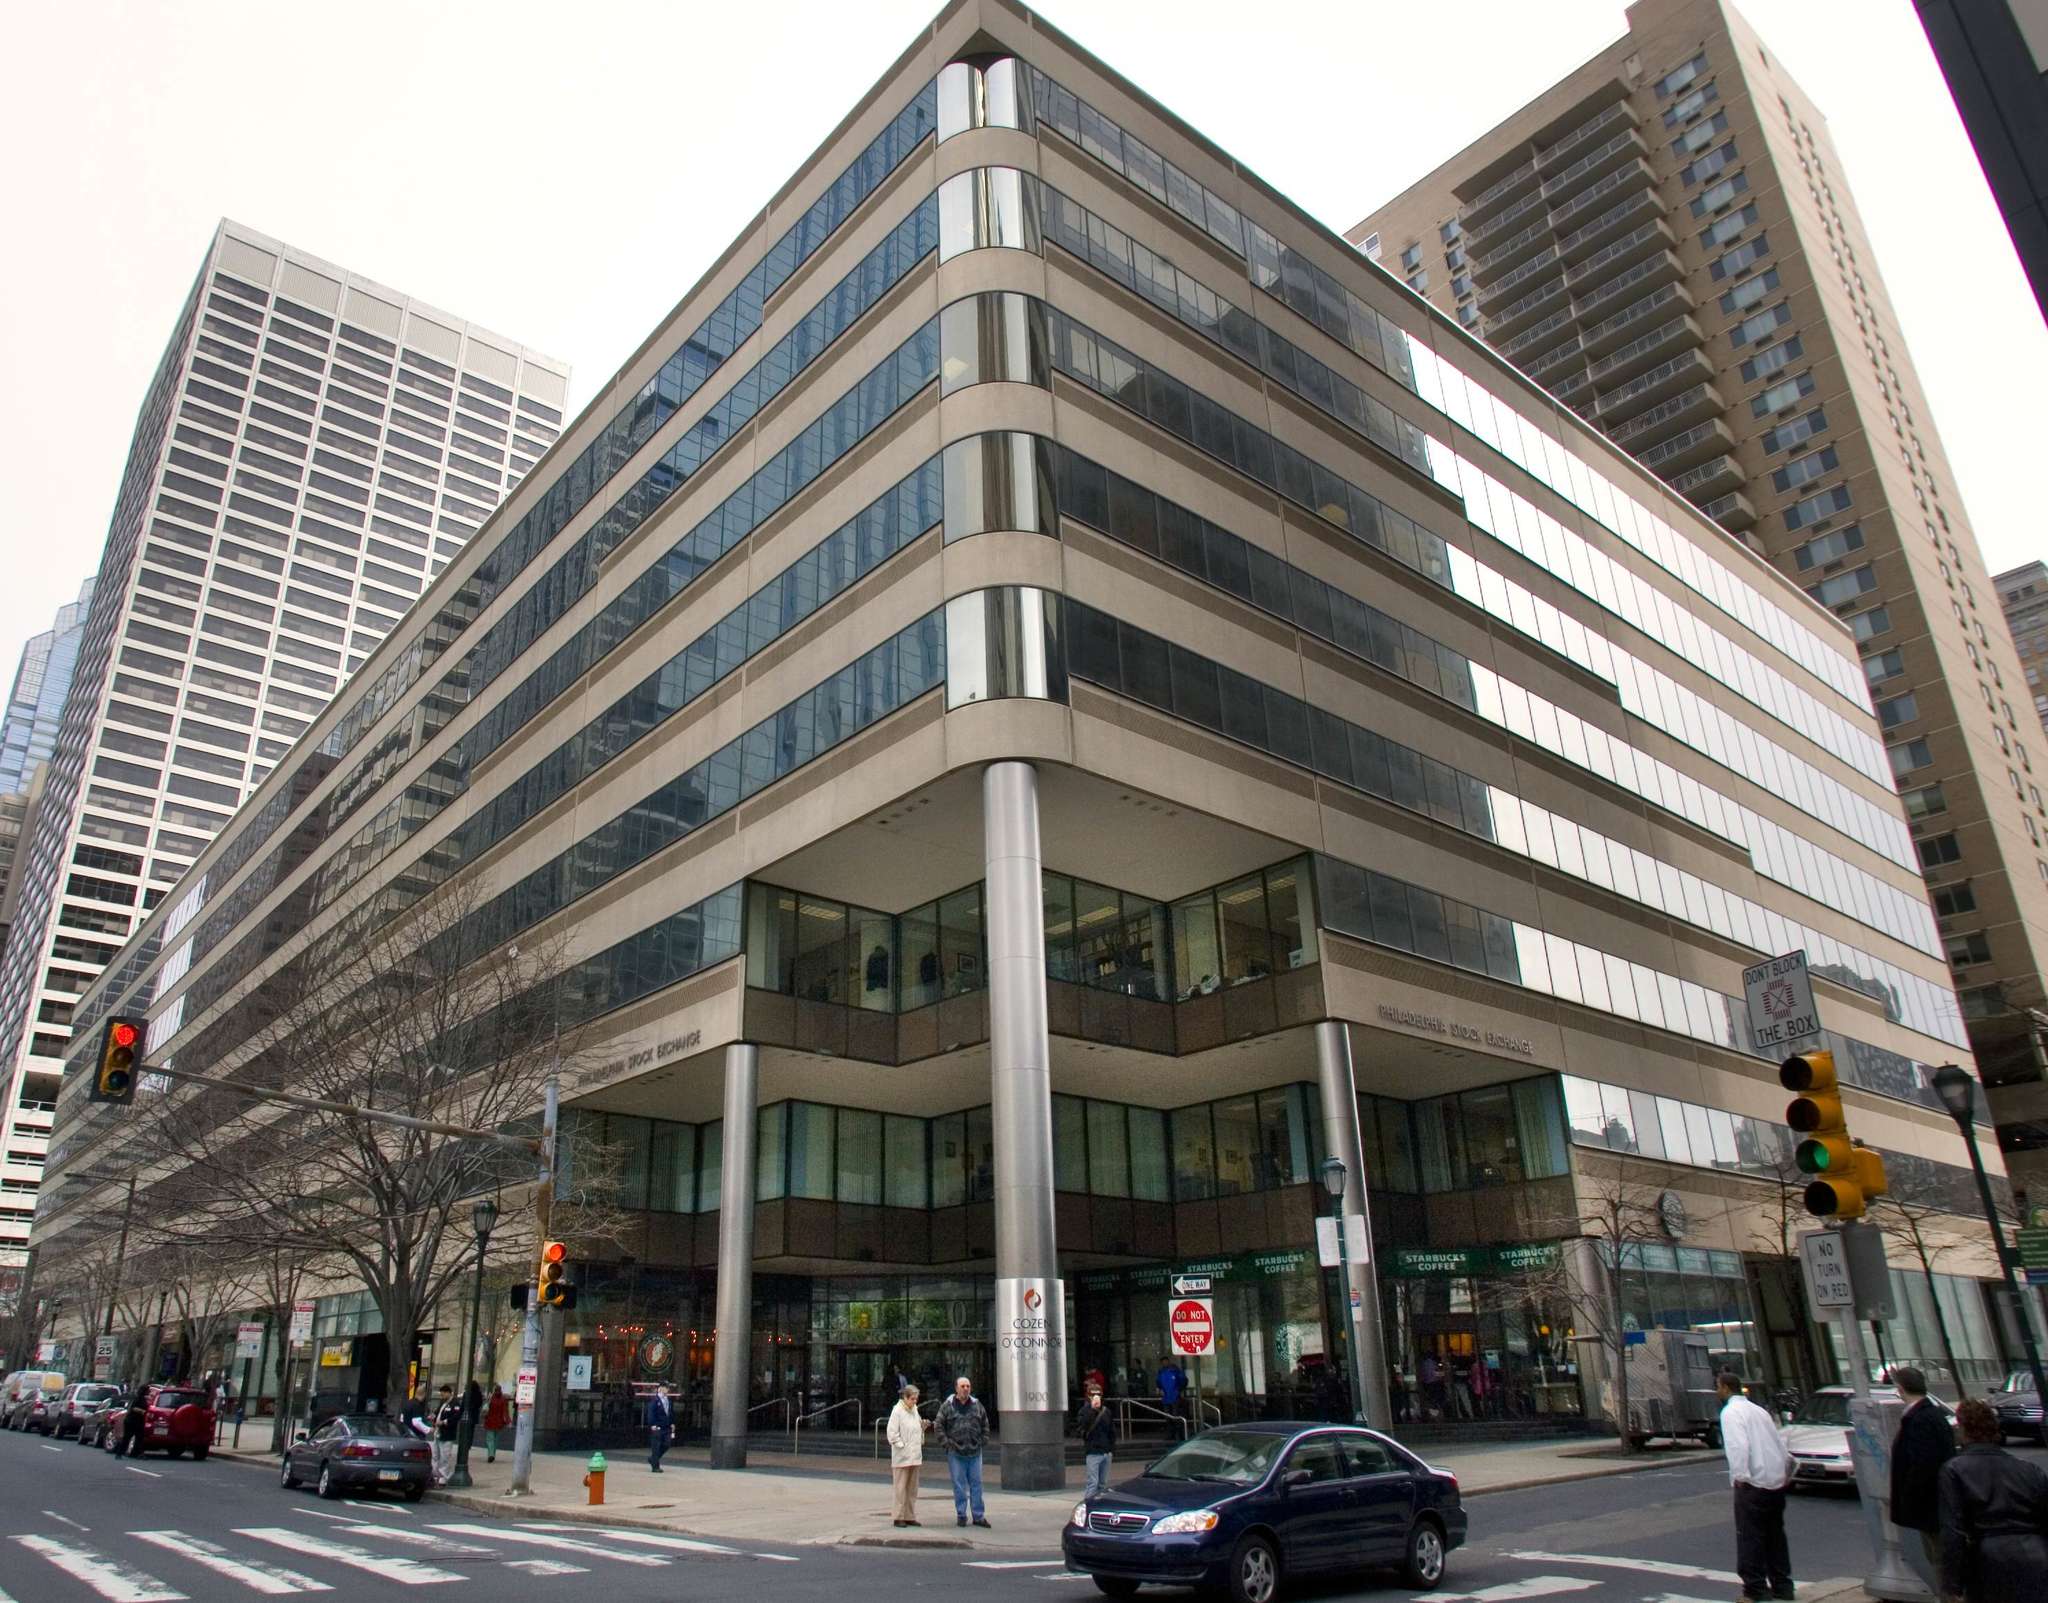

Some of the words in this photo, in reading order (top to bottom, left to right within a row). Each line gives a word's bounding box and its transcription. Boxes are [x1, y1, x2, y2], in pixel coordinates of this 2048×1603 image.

[1772, 954, 1803, 976] BLOCK
[1377, 1003, 1448, 1033] PHILADELPHIA
[1451, 1023, 1482, 1041] STOCK
[1486, 1031, 1534, 1056] EXCHANGE
[1757, 1024, 1782, 1044] THE
[1787, 1014, 1816, 1037] BOX
[628, 1048, 653, 1070] STOCK
[657, 1029, 702, 1059] EXCHANGE
[1500, 1246, 1557, 1260] STARBUCKS
[1818, 1240, 1834, 1257] NO
[1255, 1253, 1304, 1266] STARBUCKS
[1405, 1253, 1467, 1263] STARBUCKS
[1511, 1256, 1547, 1267] COFFEE
[1187, 1261, 1232, 1273] STARBUCKS
[1264, 1263, 1296, 1274] COFFEE
[1418, 1262, 1456, 1271] COFFEE
[1817, 1263, 1841, 1277] TURN
[1182, 1280, 1194, 1289] ONE
[1195, 1279, 1207, 1288] WAY
[1817, 1284, 1828, 1297] ON
[1832, 1283, 1849, 1297] RED
[1176, 1311, 1187, 1319] DO
[1190, 1310, 1205, 1319] NOT
[1013, 1318, 1052, 1329] COZEN
[1002, 1337, 1062, 1349] O'CONNOR
[1180, 1334, 1204, 1343] ENTER
[98, 1346, 113, 1355] 25
